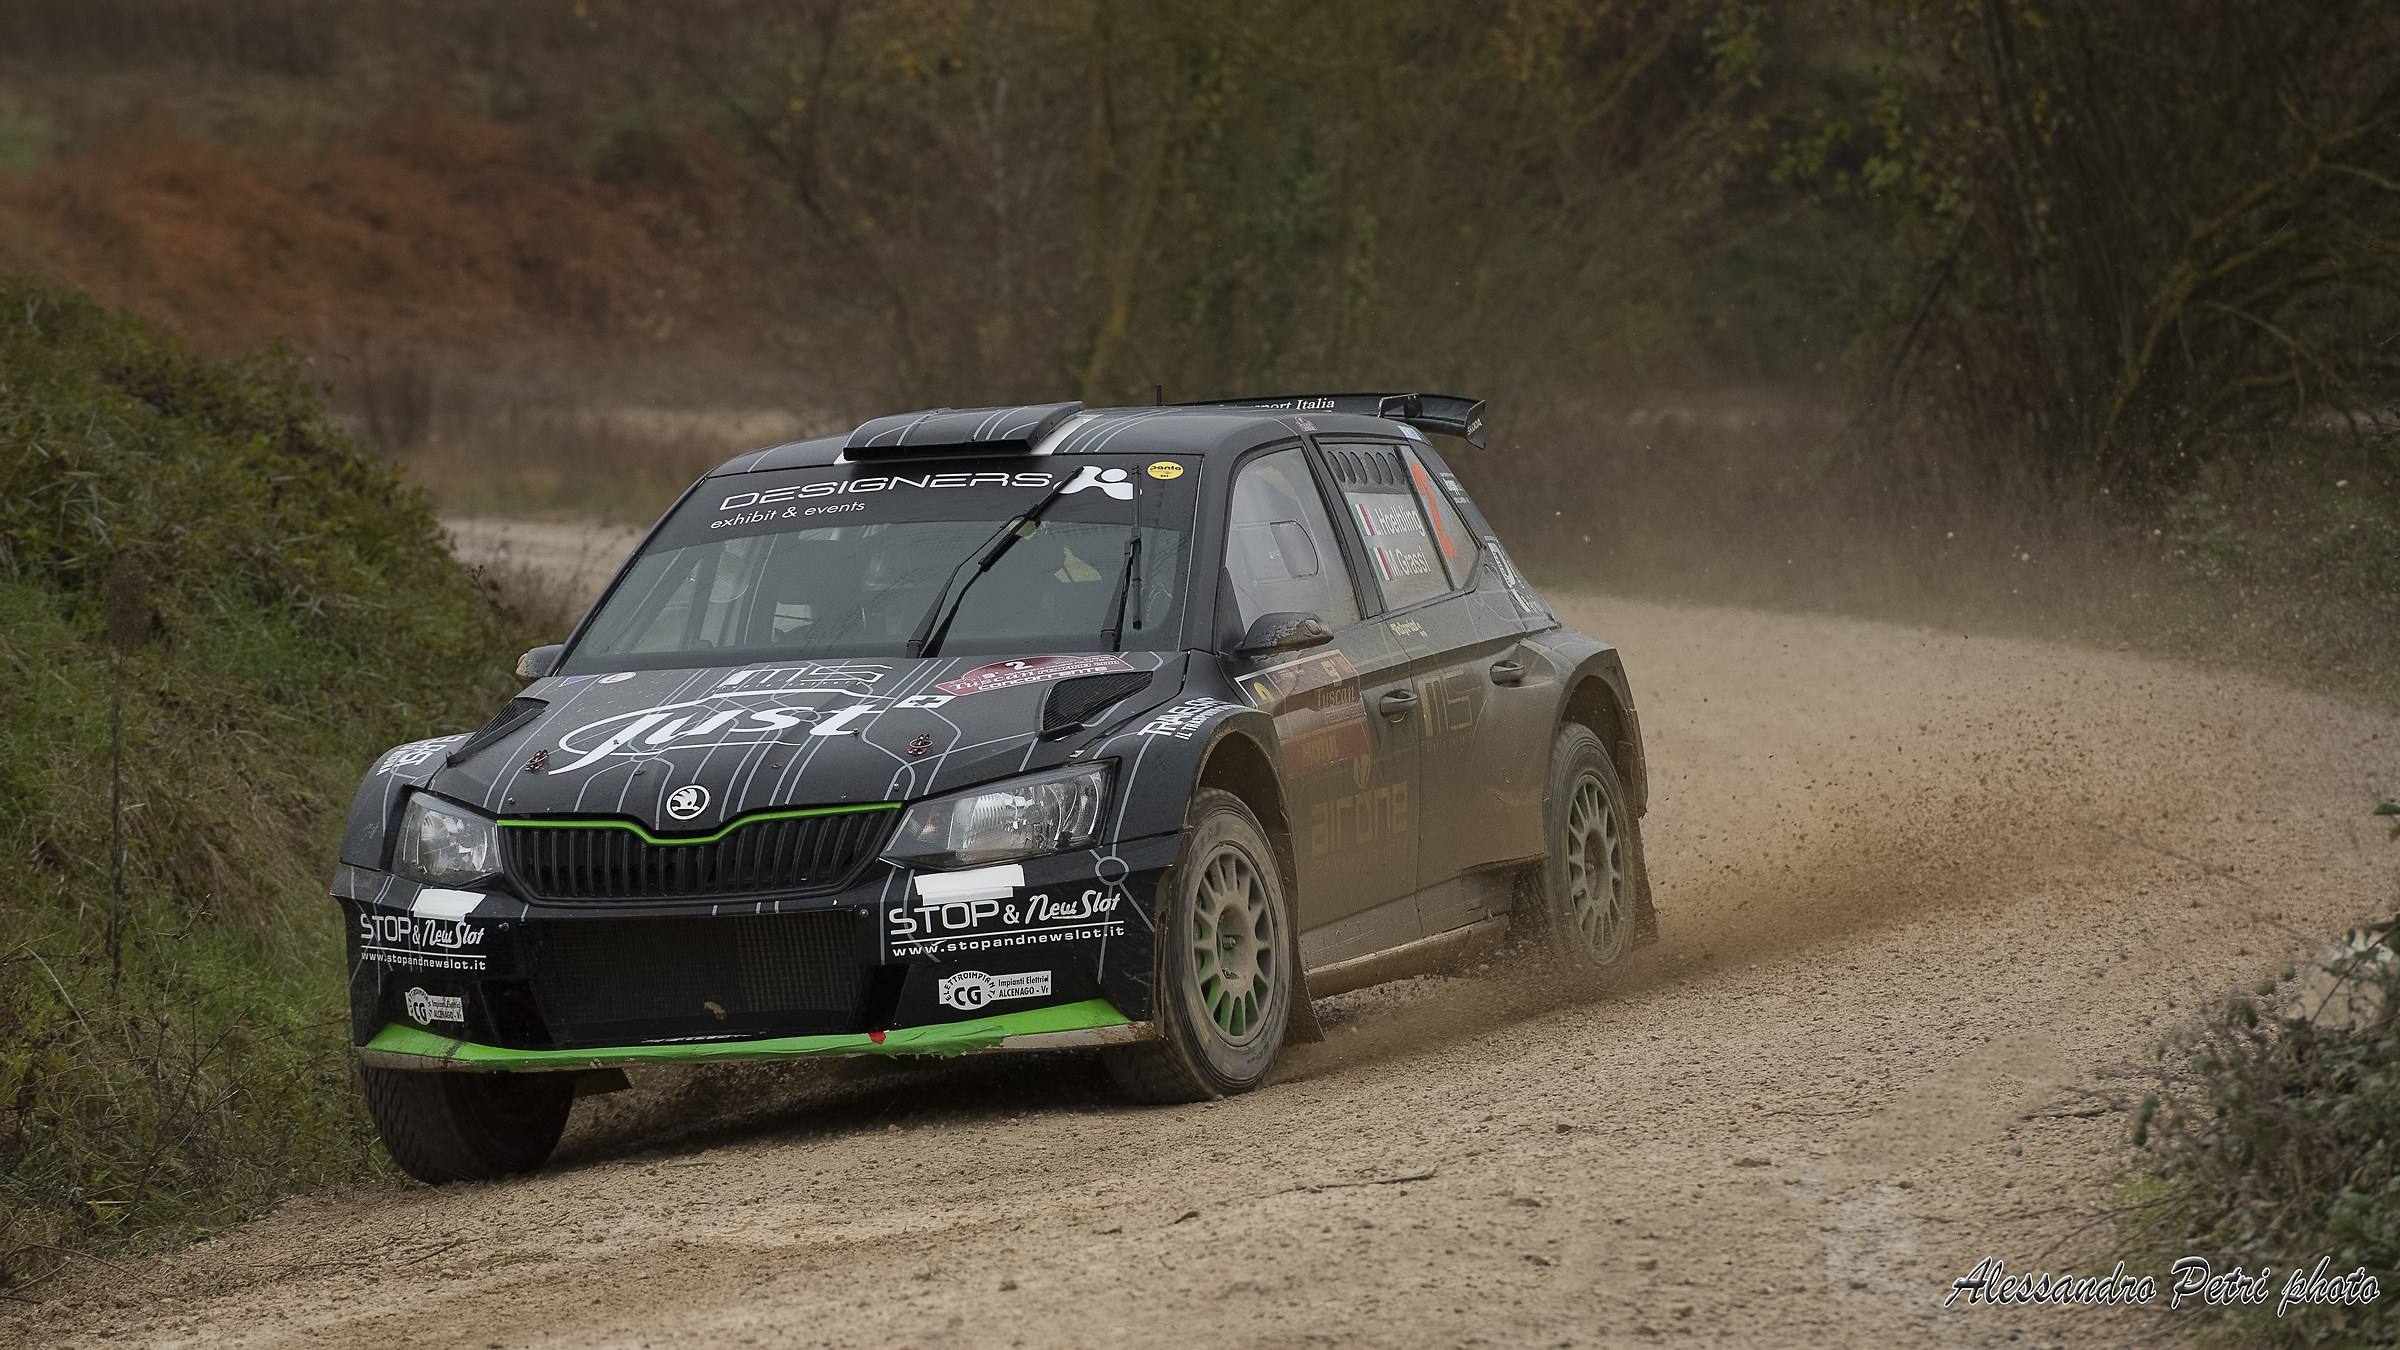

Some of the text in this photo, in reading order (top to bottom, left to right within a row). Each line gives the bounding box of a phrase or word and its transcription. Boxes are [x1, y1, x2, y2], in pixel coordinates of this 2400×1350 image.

[1296, 398, 1334, 409] Italia
[719, 473, 1053, 511] DESIGNERS
[710, 501, 866, 529] exhibit & events
[1411, 462, 1456, 558] 2
[548, 693, 888, 775] Just
[888, 889, 1121, 935] STOP & New Slot
[360, 913, 484, 948] STOP & New Slot
[892, 926, 1125, 957] www.stopandnewslot.it
[361, 952, 486, 971] www.stopandnewslot.it
[943, 972, 996, 1001] ELETTROIMPIANTI
[953, 985, 982, 1006] CG
[998, 978, 1025, 987] Impianti
[999, 986, 1035, 998] ALCENAGO
[413, 1001, 428, 1021] CG
